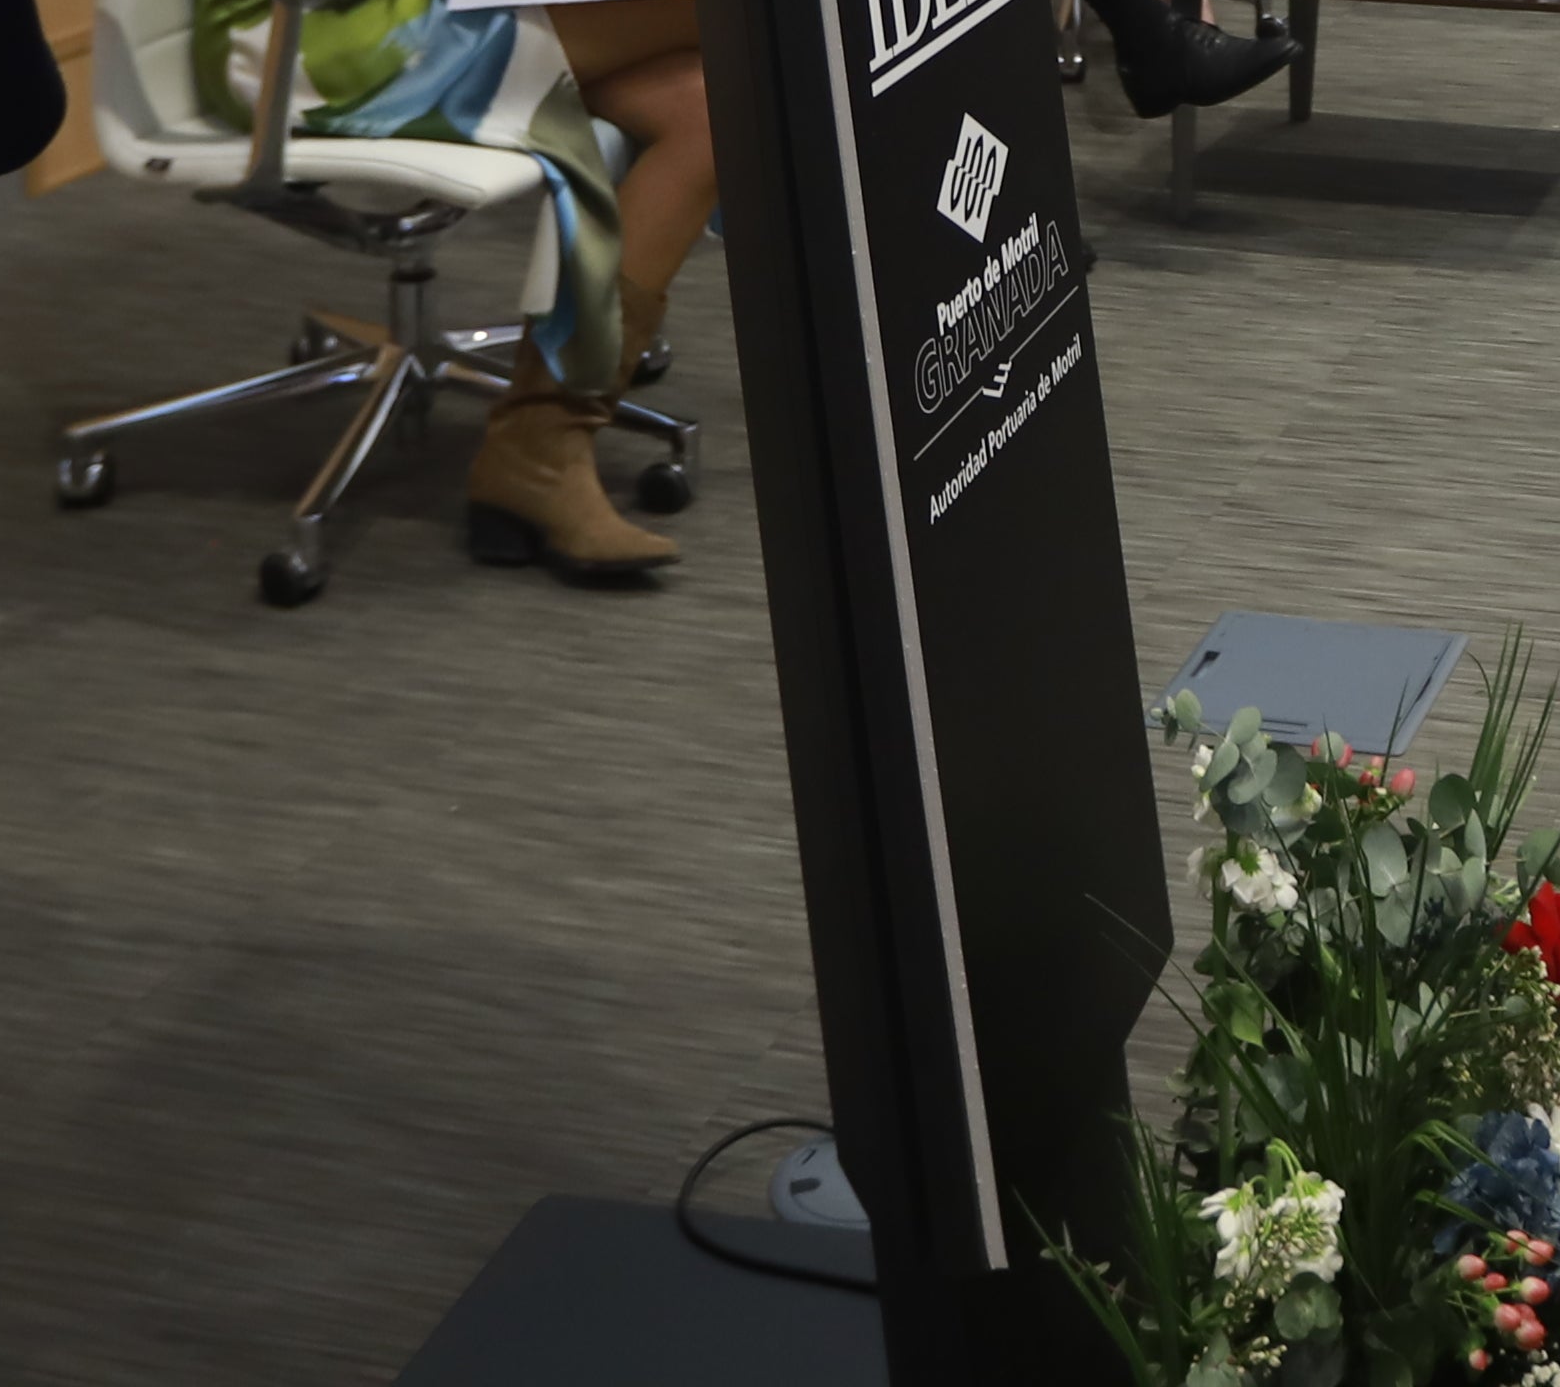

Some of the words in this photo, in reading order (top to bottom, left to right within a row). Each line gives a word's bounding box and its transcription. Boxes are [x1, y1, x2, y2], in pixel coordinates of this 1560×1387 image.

[914, 220, 1070, 414] GRANADA
[936, 276, 982, 336] Puerto
[983, 256, 1001, 292] de
[1001, 212, 1040, 275] Motril
[930, 438, 988, 525] Autoridad
[987, 389, 1038, 458] Portuaria
[1037, 372, 1051, 402] de
[1051, 332, 1083, 380] Motril
